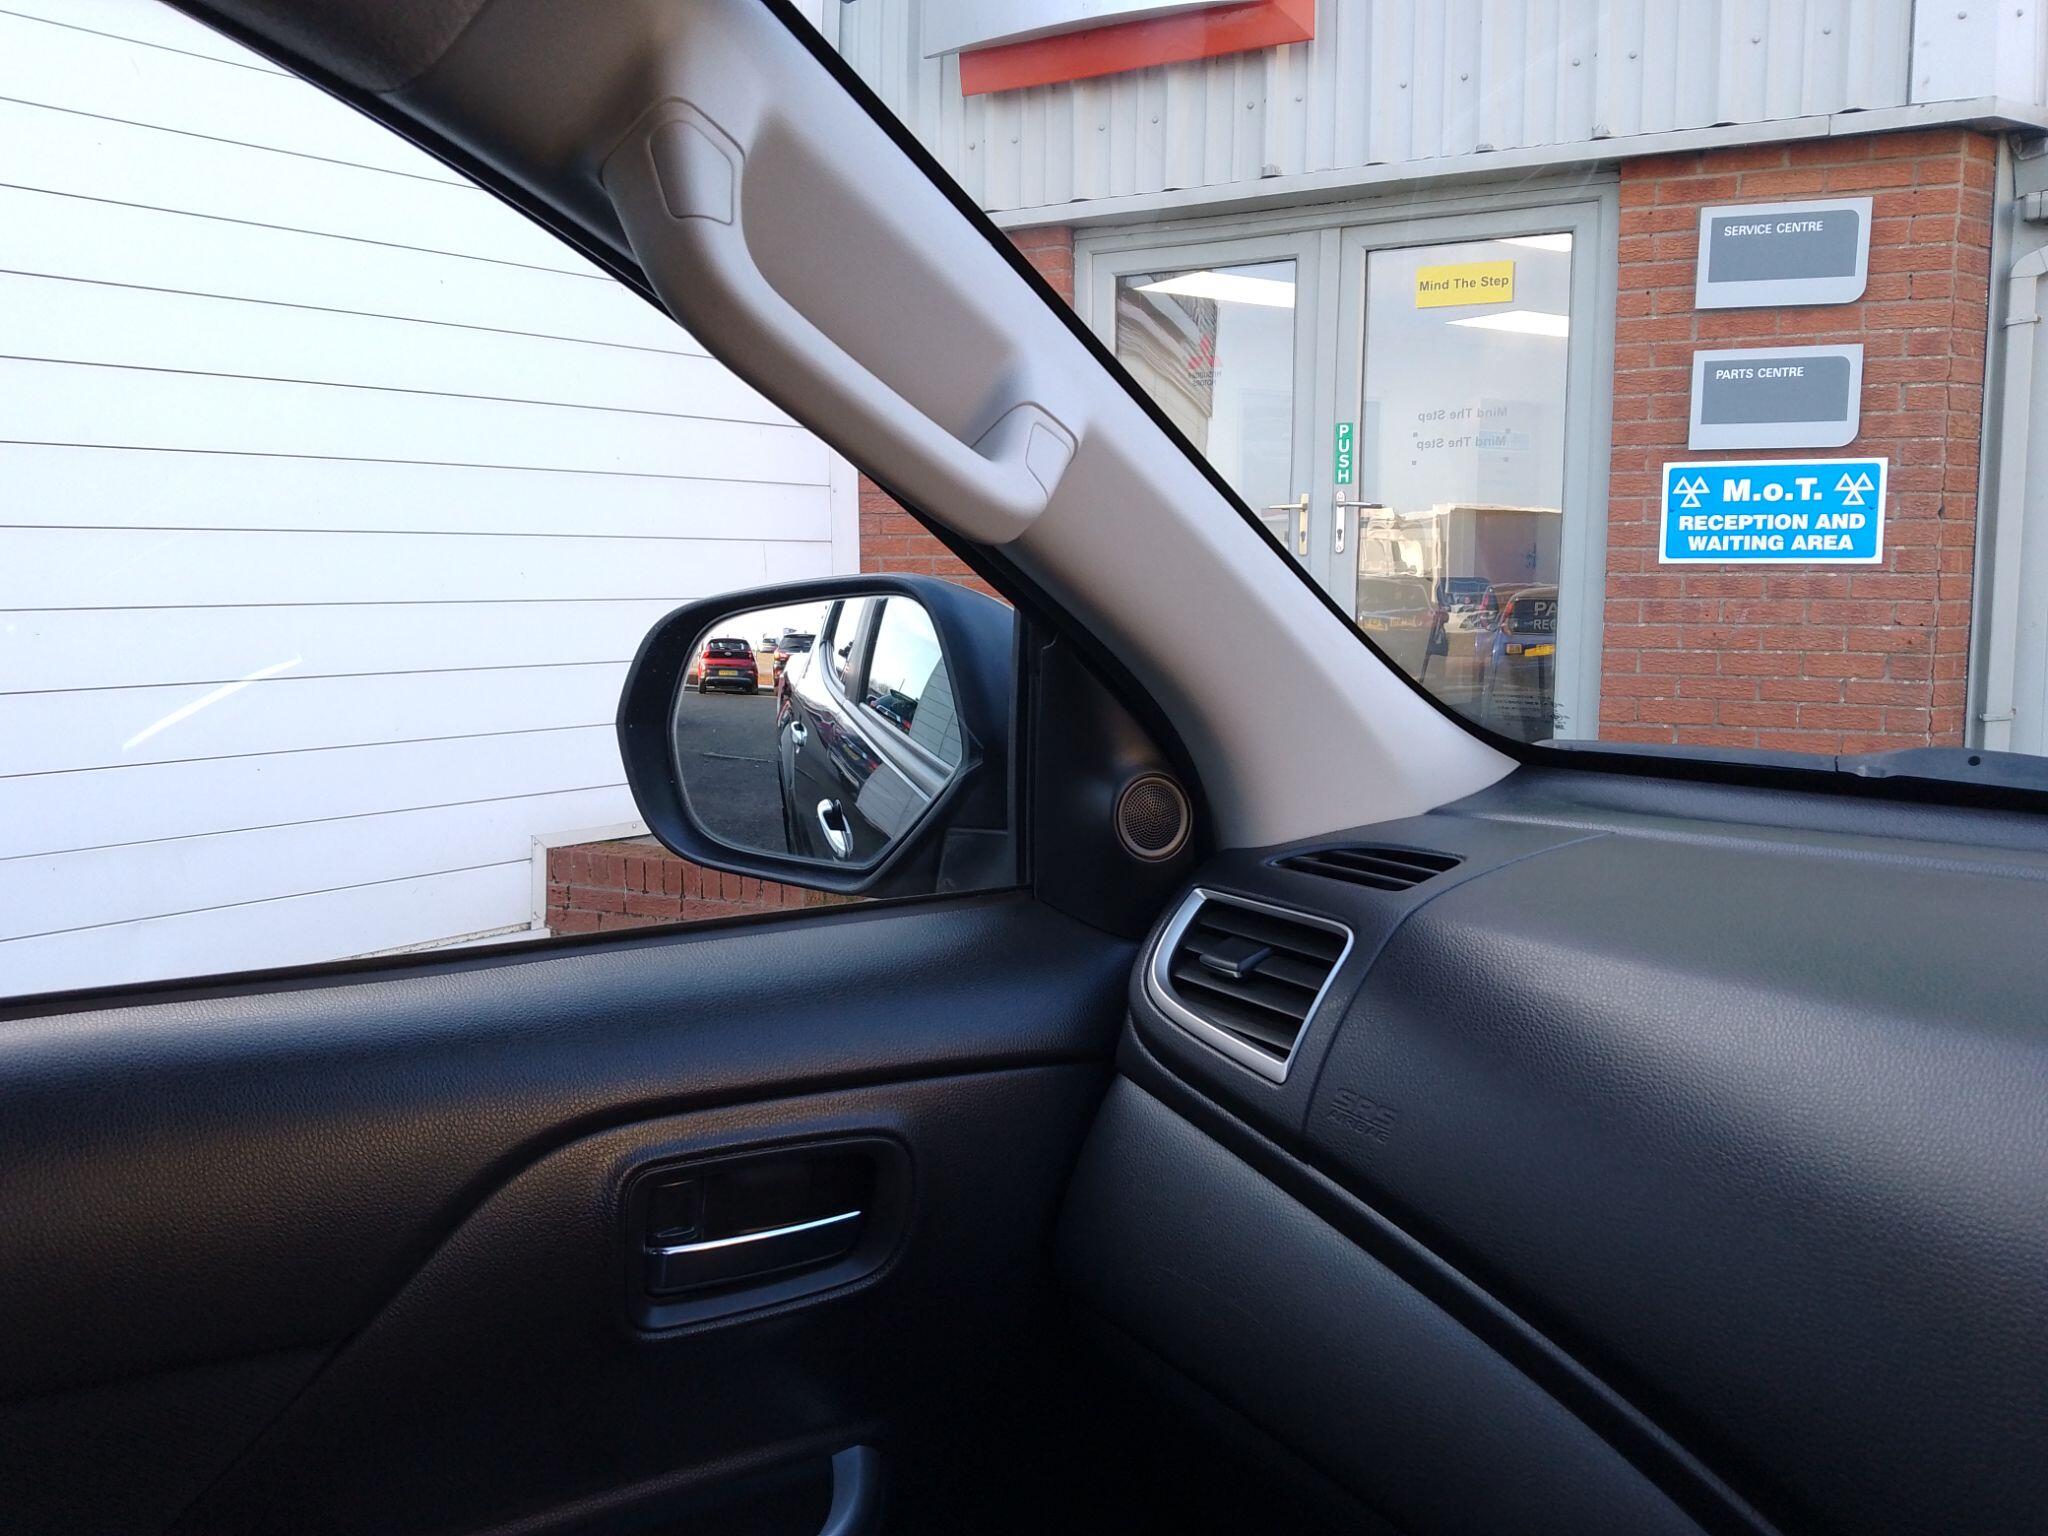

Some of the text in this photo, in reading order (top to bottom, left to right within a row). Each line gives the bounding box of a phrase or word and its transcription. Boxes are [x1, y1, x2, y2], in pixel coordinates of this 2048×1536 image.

[1724, 221, 1824, 237] SERVICE CENTRE
[1419, 276, 1510, 292] Mind The Step
[1715, 366, 1805, 380] PARTS CENTRE
[1337, 424, 1350, 483] PUSH
[1722, 477, 1822, 502] M.o.T.
[1679, 513, 1866, 531] RECEPTION AND
[1688, 534, 1854, 551] WAITING AREA
